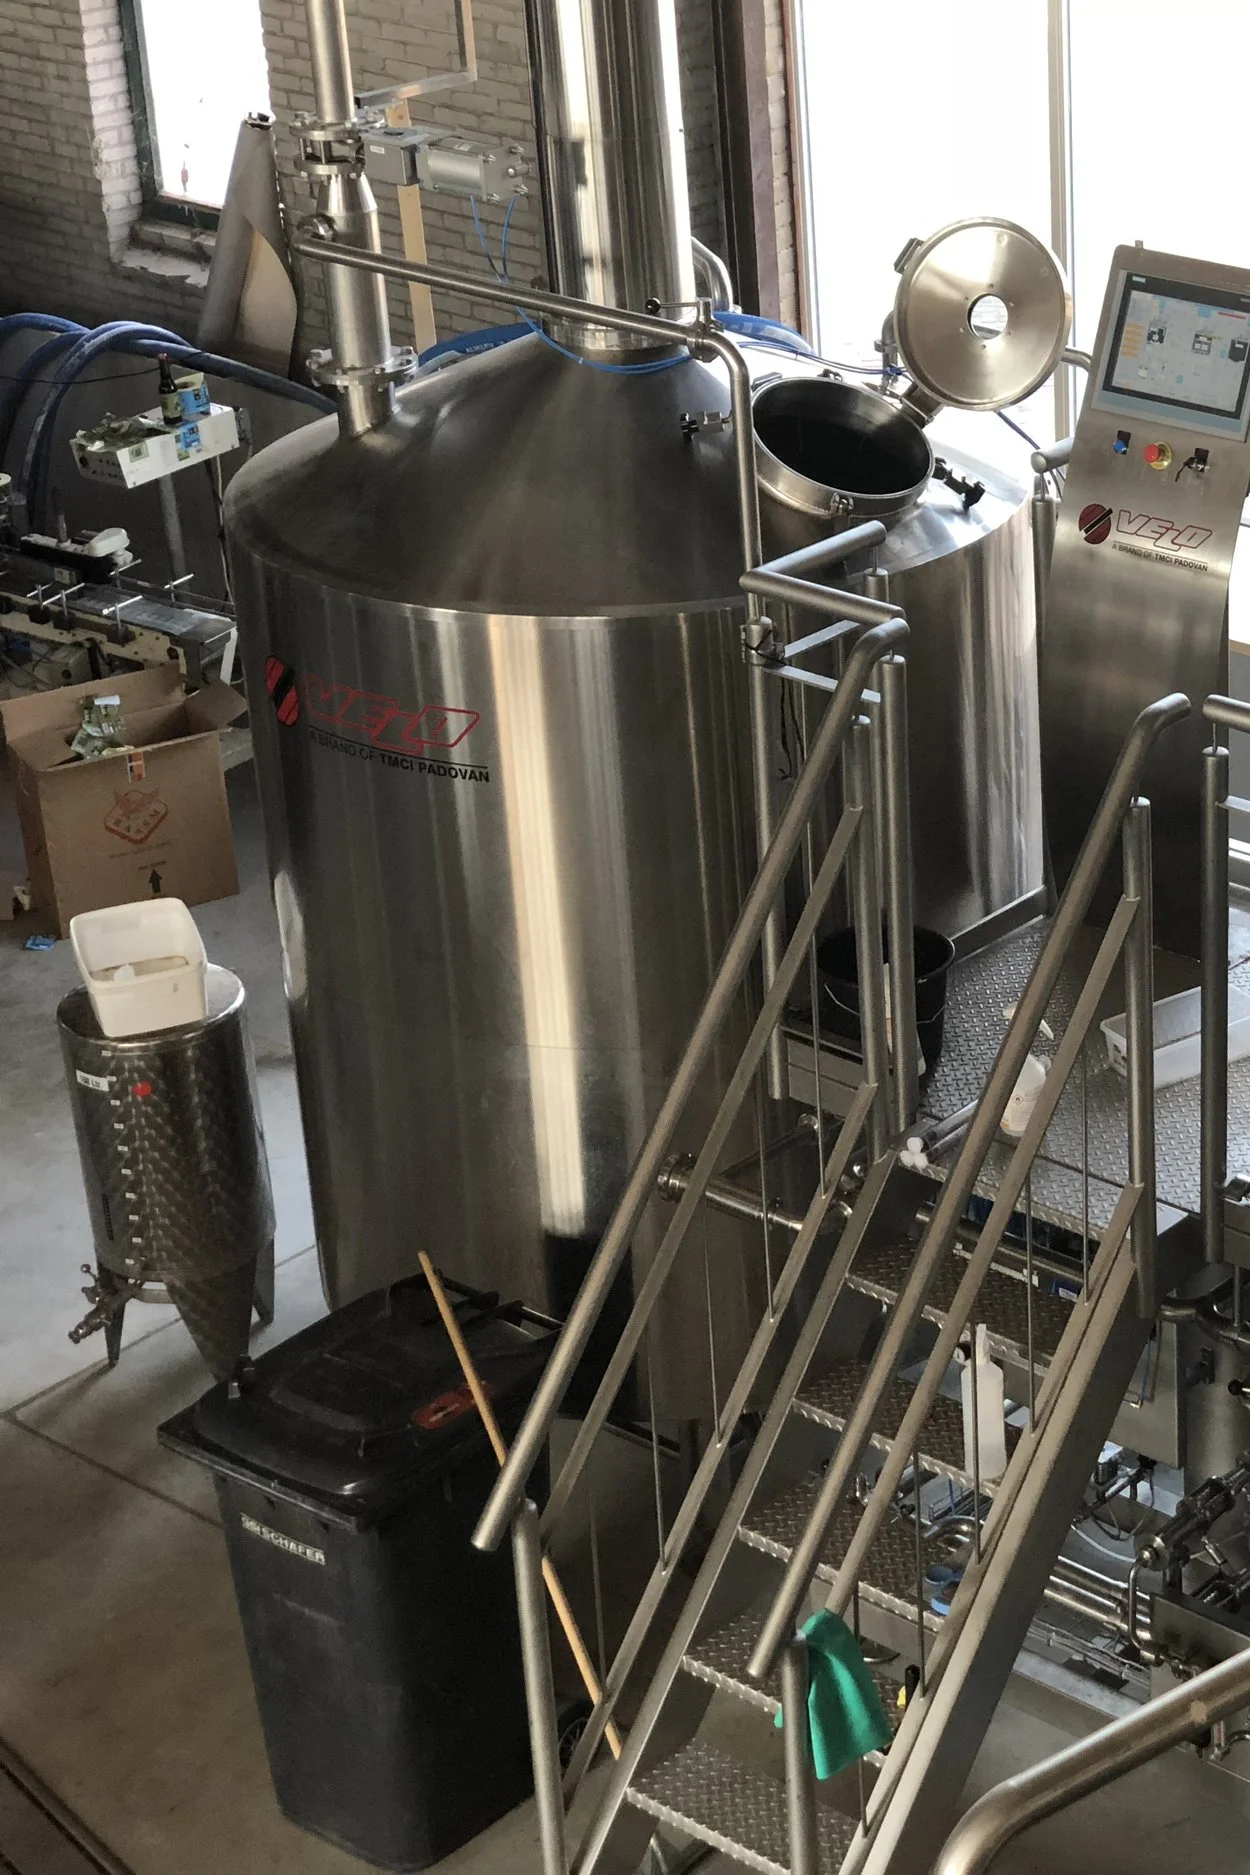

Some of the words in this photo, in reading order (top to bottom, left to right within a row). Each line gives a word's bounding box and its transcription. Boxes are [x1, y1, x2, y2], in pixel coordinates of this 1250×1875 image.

[1116, 509, 1213, 552] VELO
[1118, 545, 1143, 557] BRAND
[1143, 550, 1152, 559] OF
[1154, 554, 1173, 564] TMCI
[1173, 558, 1209, 572] PADOVAN
[303, 672, 480, 756] VELO
[318, 733, 356, 758] BRAND
[359, 747, 377, 761] OF
[379, 752, 415, 772] TMCI
[418, 762, 491, 783] PADOVAN
